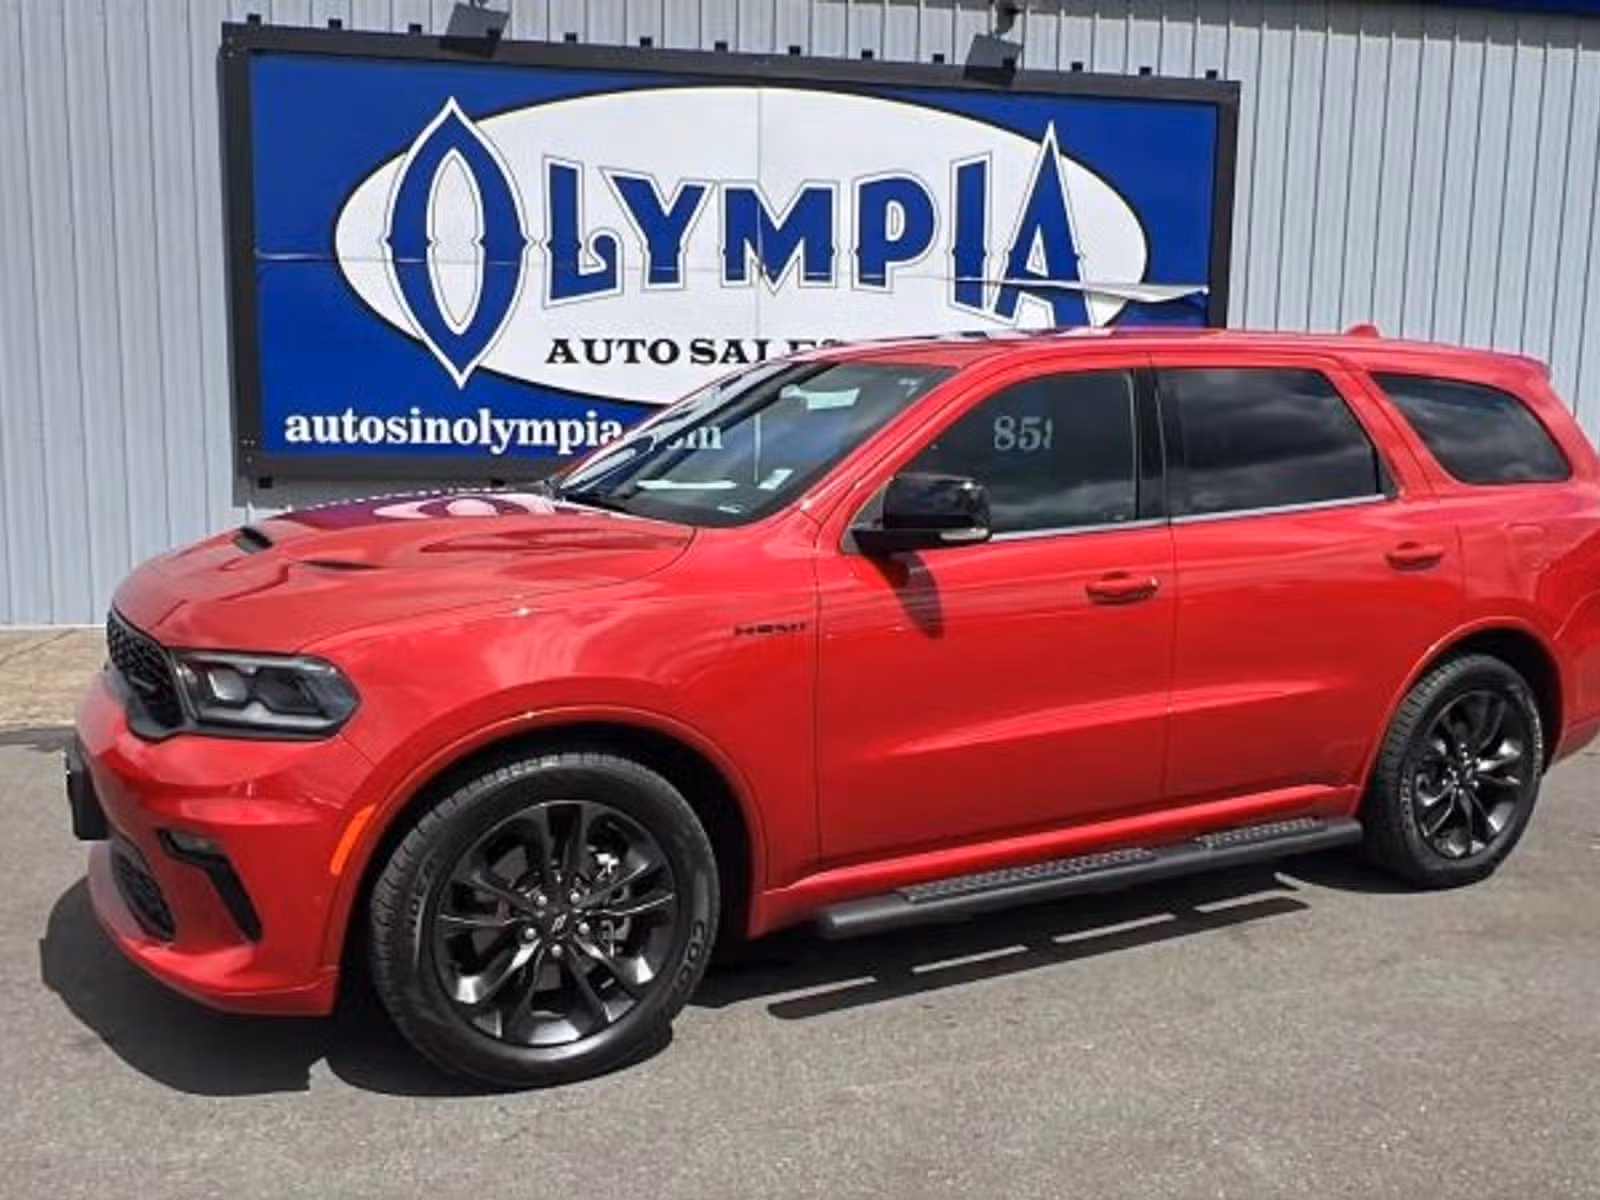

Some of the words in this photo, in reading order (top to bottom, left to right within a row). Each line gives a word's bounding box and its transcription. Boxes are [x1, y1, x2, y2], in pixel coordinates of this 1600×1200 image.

[384, 97, 1092, 389] OLYMPIA
[545, 338, 680, 364] AUTO
[690, 338, 850, 365] SAL
[284, 407, 724, 454] autosinolympiam
